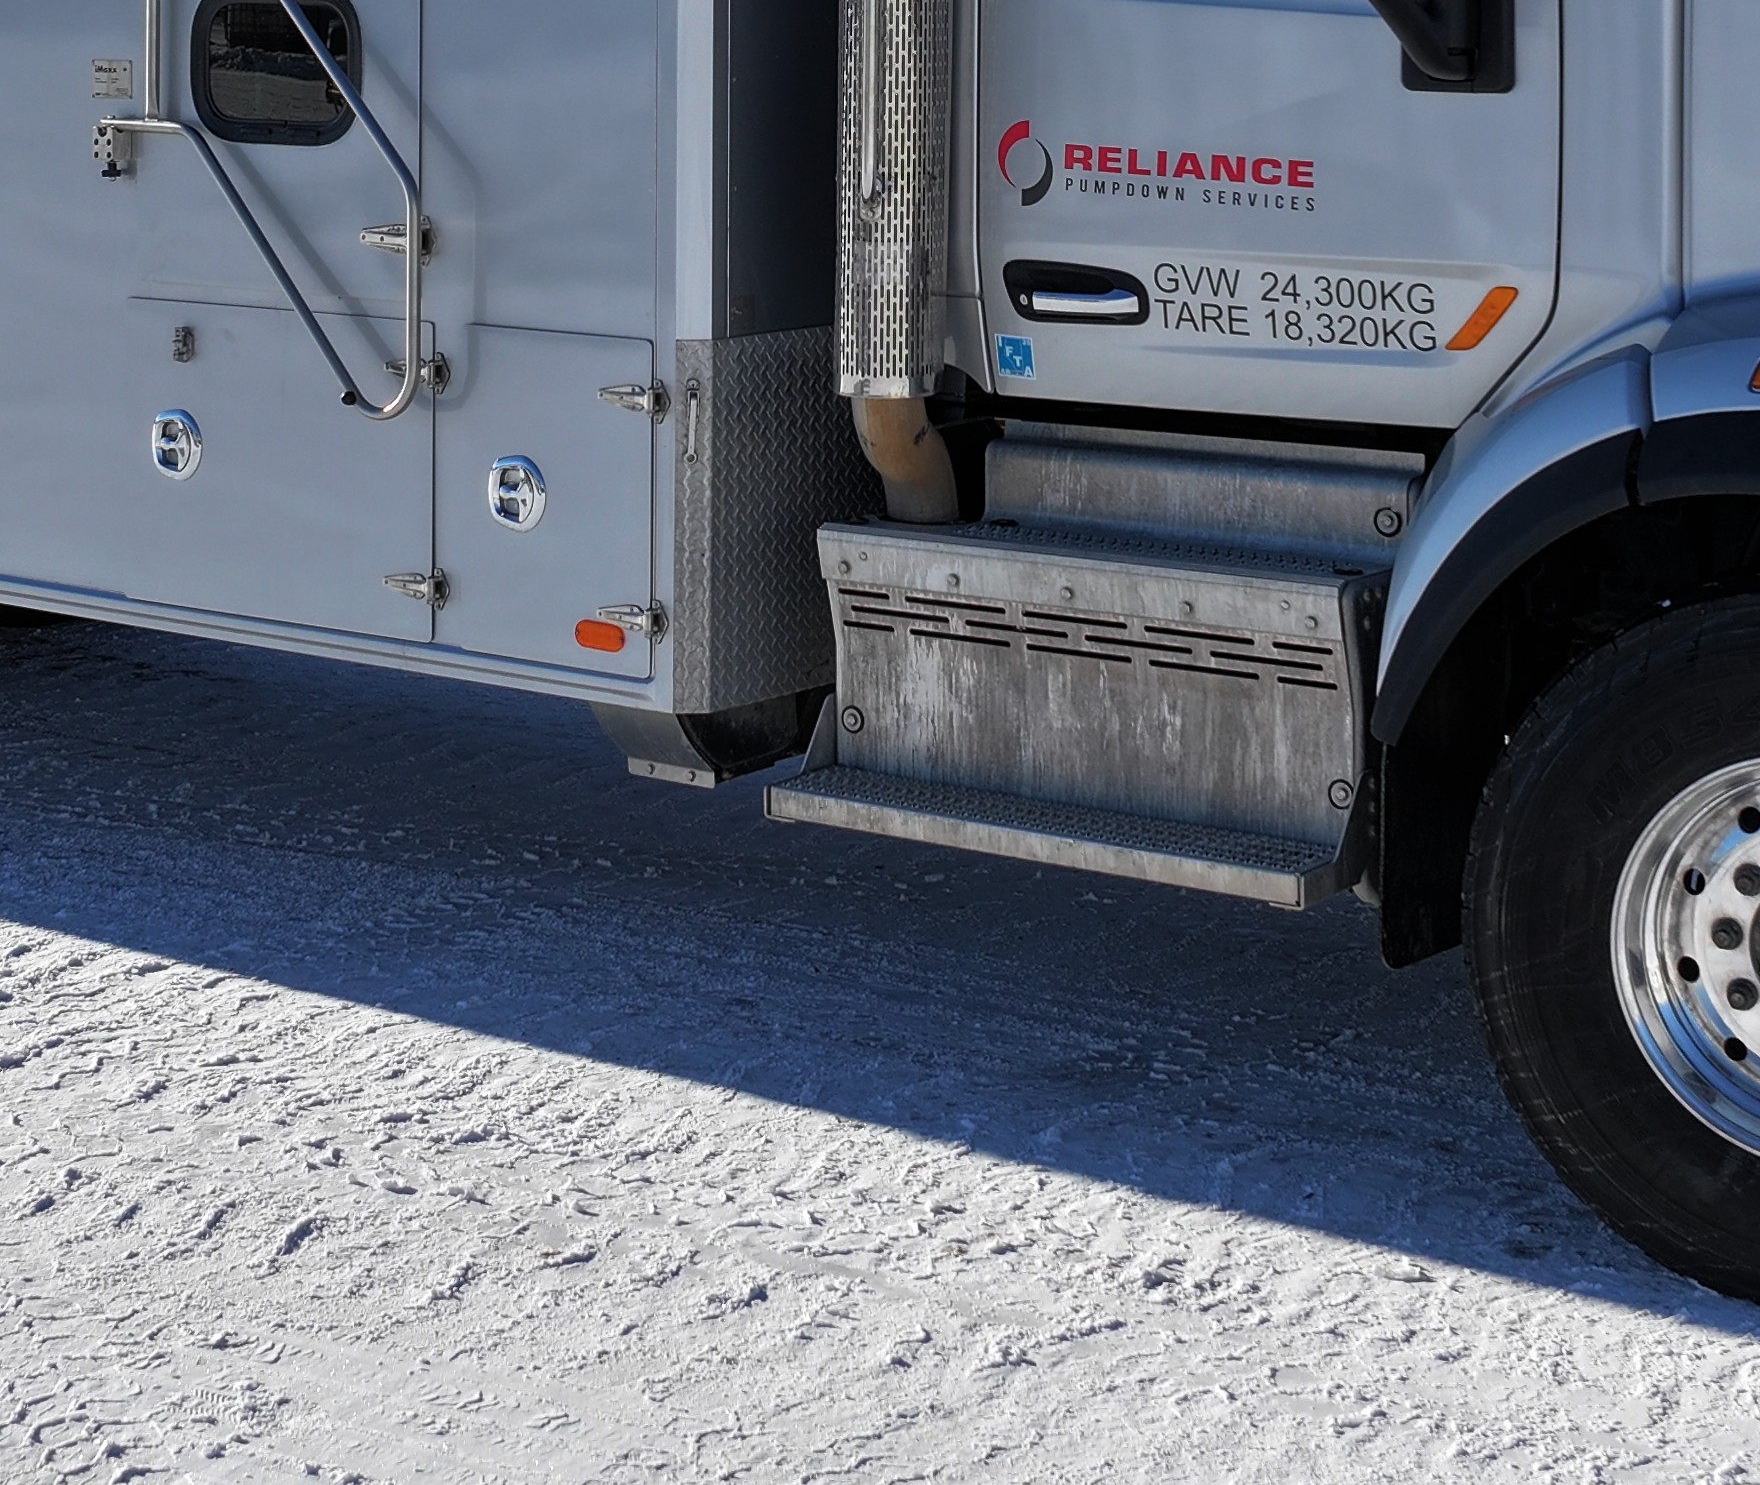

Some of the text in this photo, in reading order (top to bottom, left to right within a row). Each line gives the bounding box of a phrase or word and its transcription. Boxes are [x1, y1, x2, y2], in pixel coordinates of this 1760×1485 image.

[1062, 142, 1316, 189] RELIANCE
[1064, 176, 1317, 213] PUMPDOWN SERVICES
[1153, 262, 1436, 315] GVW 24,300KG
[1153, 298, 1438, 352] TARE 18,320KG
